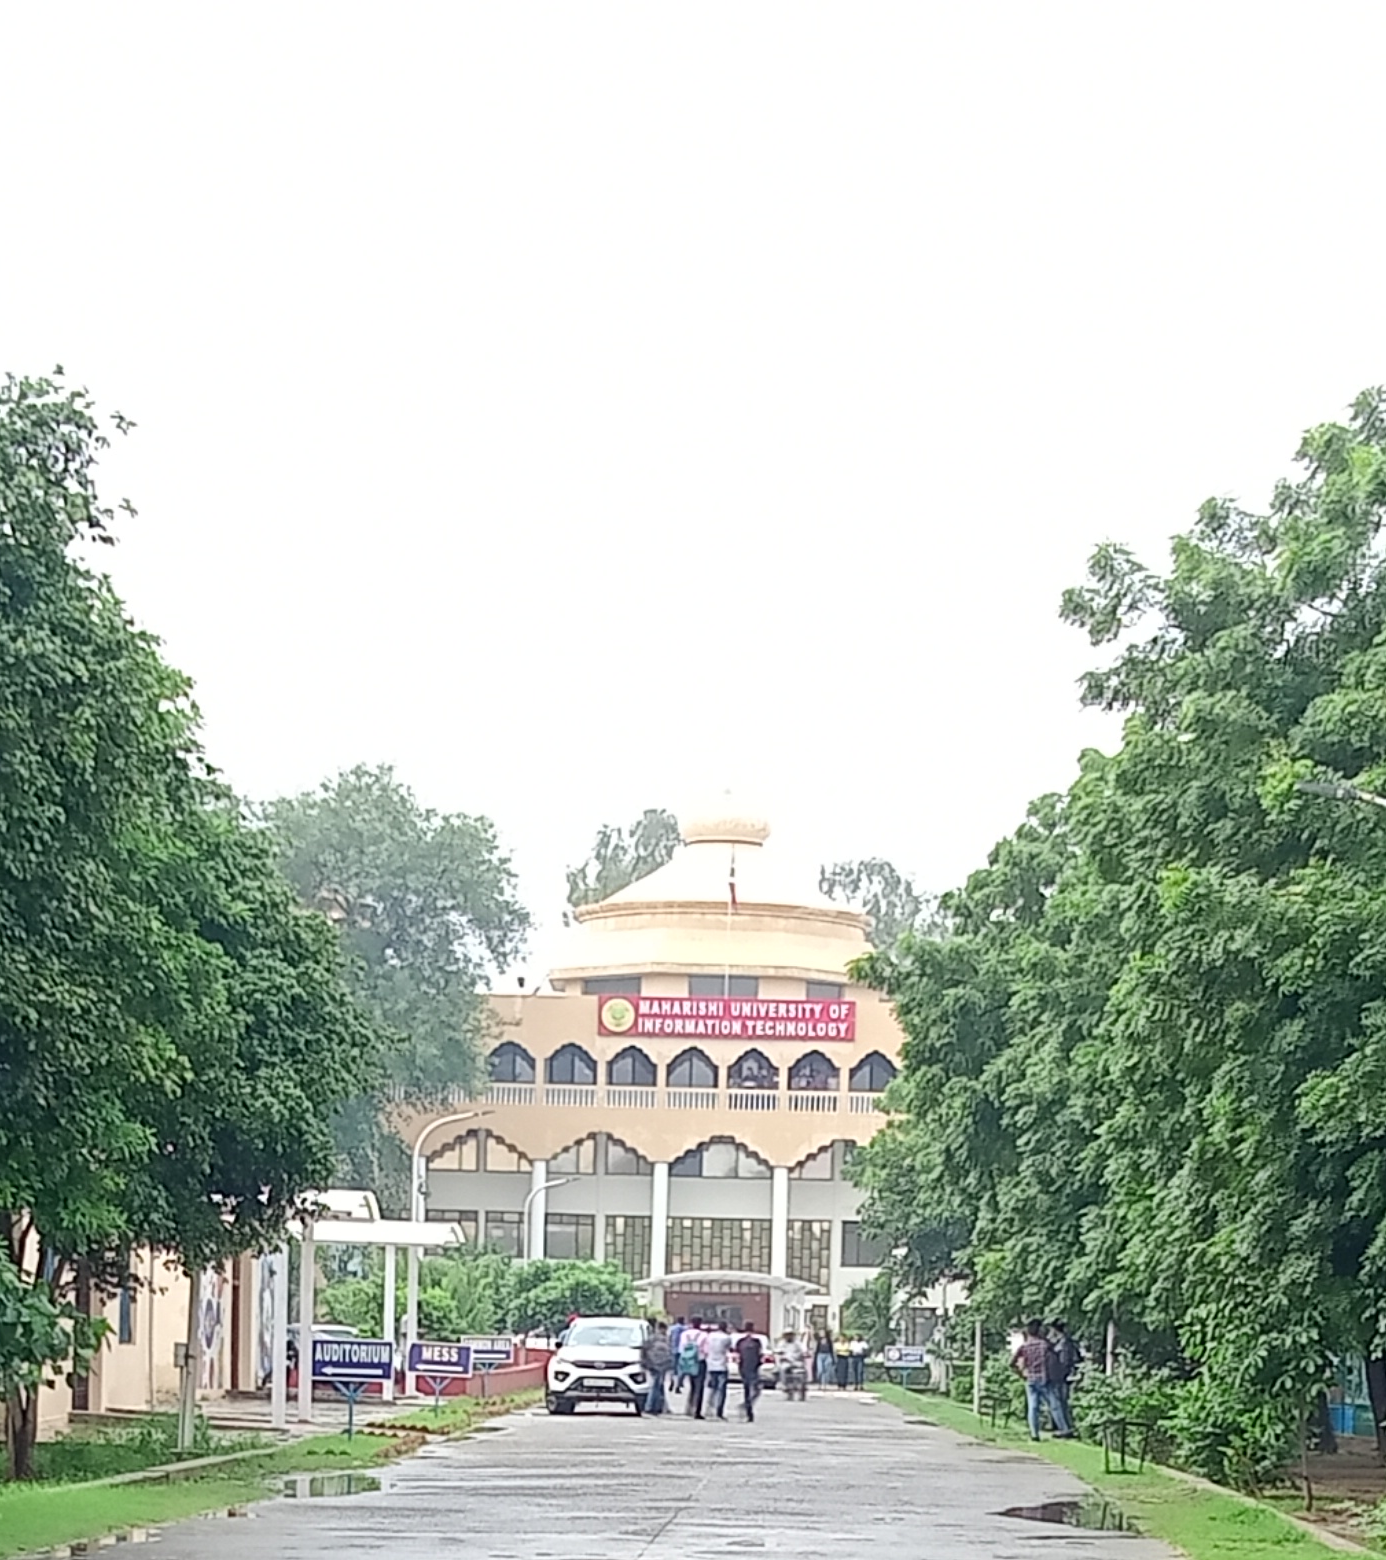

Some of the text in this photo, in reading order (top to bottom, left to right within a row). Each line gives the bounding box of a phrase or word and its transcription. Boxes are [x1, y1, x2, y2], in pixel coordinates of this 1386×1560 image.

[638, 1001, 849, 1018] MAHARISHI UNIVERSITY OF
[637, 1018, 849, 1037] INFORMATION TECHNOLOGY
[314, 1344, 391, 1364] AUDITORIUM
[421, 1346, 459, 1363] MESS
